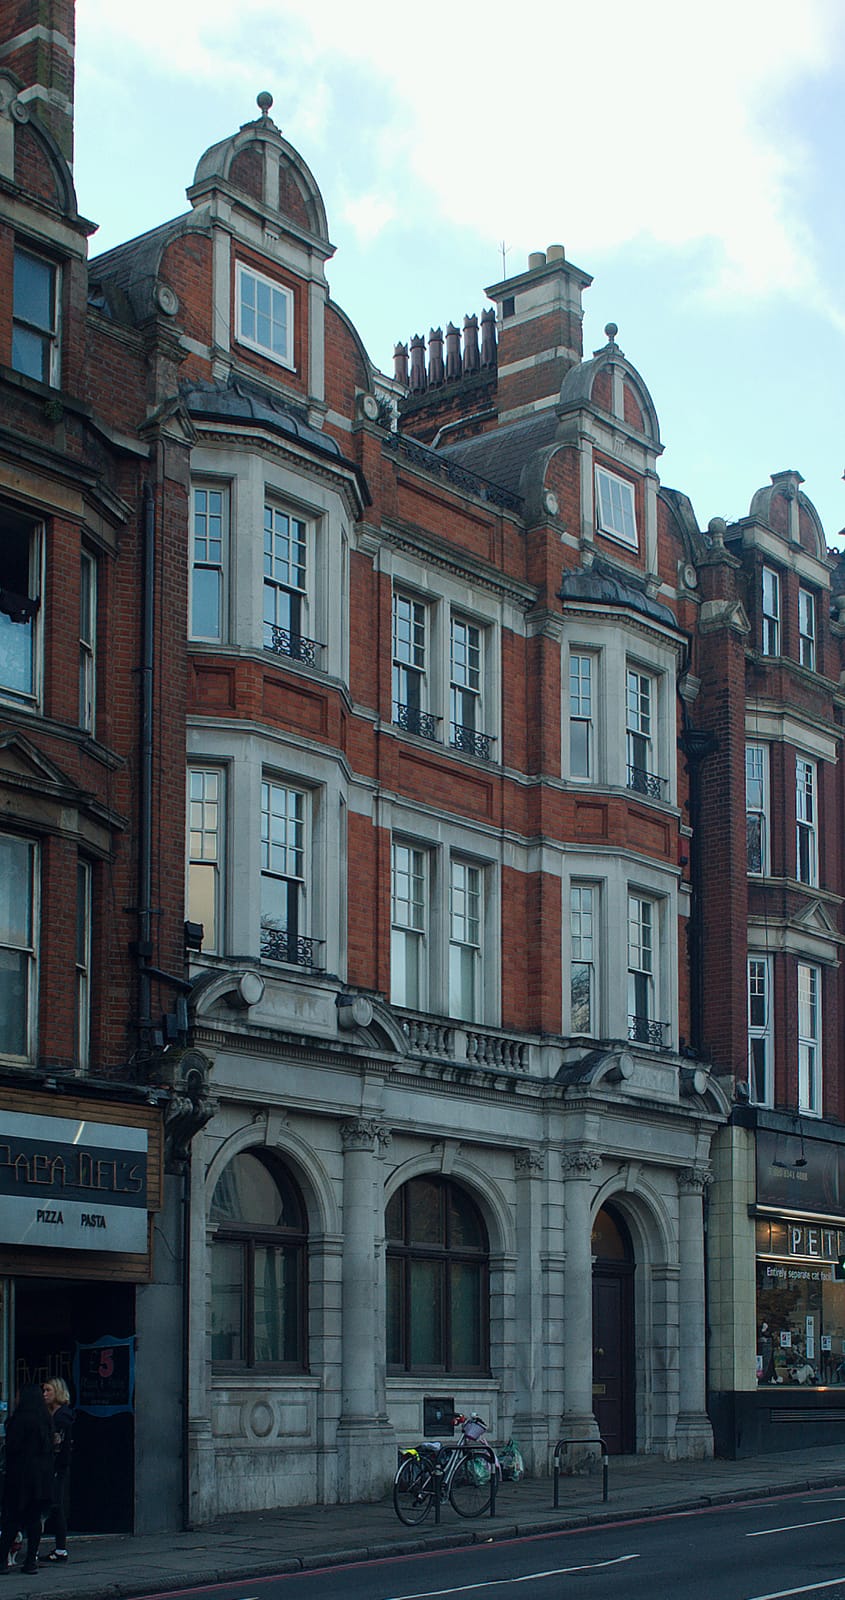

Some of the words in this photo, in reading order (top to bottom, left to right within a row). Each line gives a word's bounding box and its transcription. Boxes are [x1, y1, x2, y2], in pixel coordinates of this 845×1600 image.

[36, 1209, 64, 1225] PIZZA
[81, 1214, 106, 1228] PASTA
[766, 1266, 786, 1279] Entirely
[788, 1270, 810, 1280] separate
[812, 1272, 820, 1280] cat
